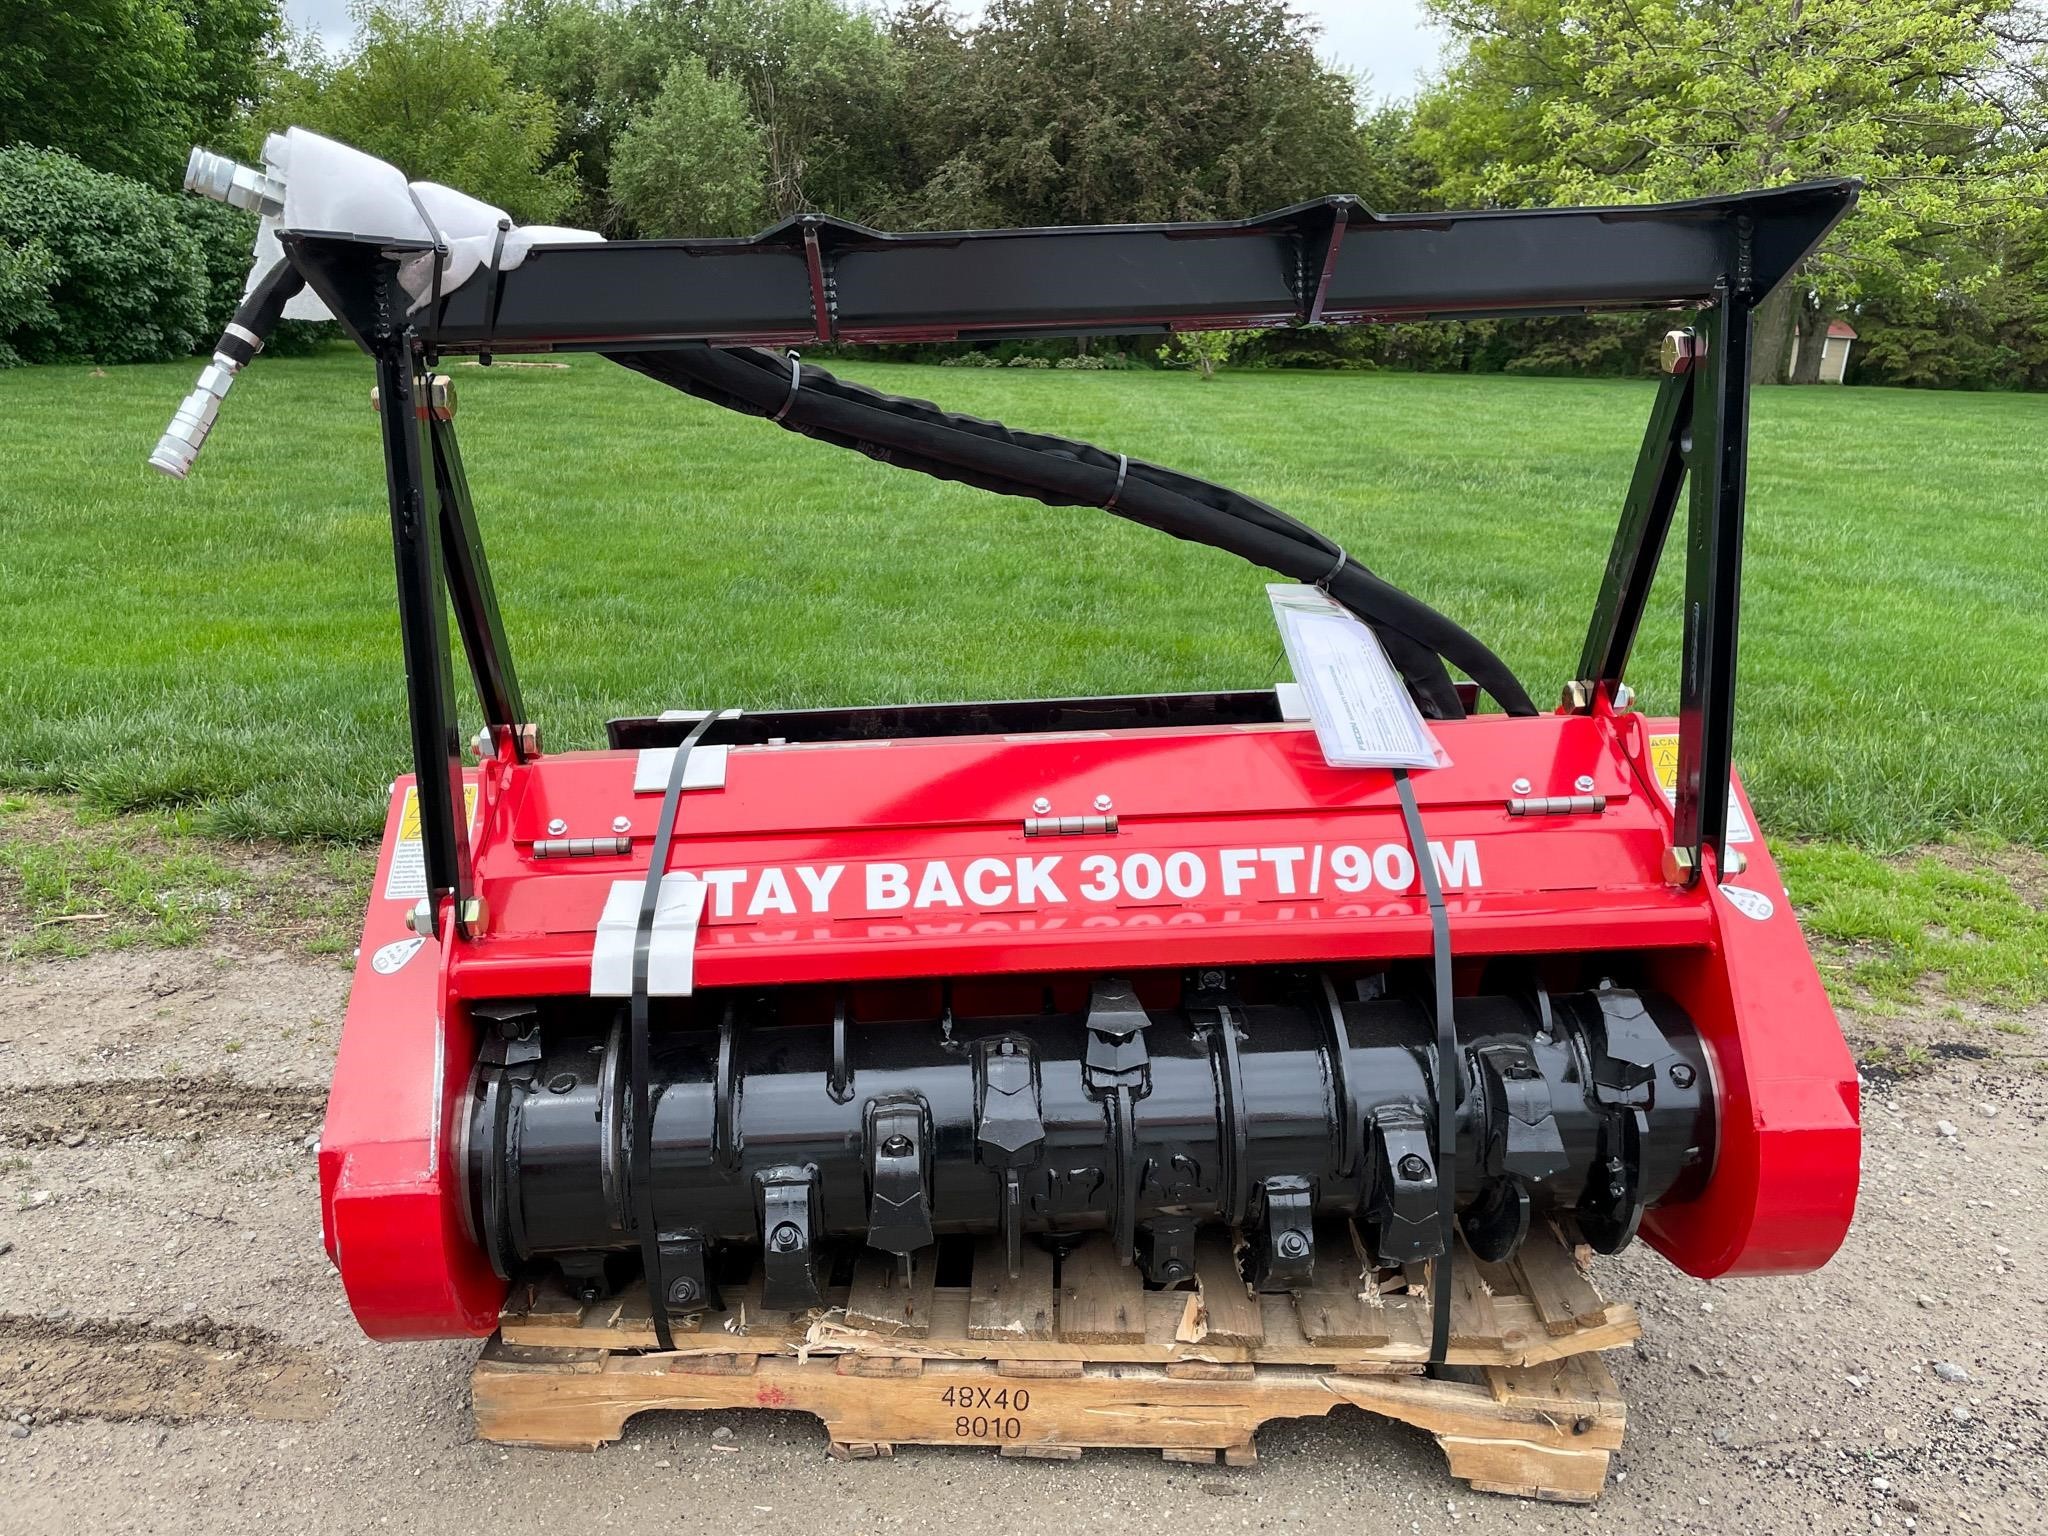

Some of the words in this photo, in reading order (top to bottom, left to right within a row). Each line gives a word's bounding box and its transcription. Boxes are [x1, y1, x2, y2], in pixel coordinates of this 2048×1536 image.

[662, 865, 845, 917] TAY
[865, 856, 1068, 911] BACK
[1079, 852, 1206, 902] 300
[1219, 844, 1415, 896] FT/90
[1426, 840, 1483, 888] M
[941, 1385, 1030, 1411] 48X40
[955, 1416, 1021, 1439] 8010
